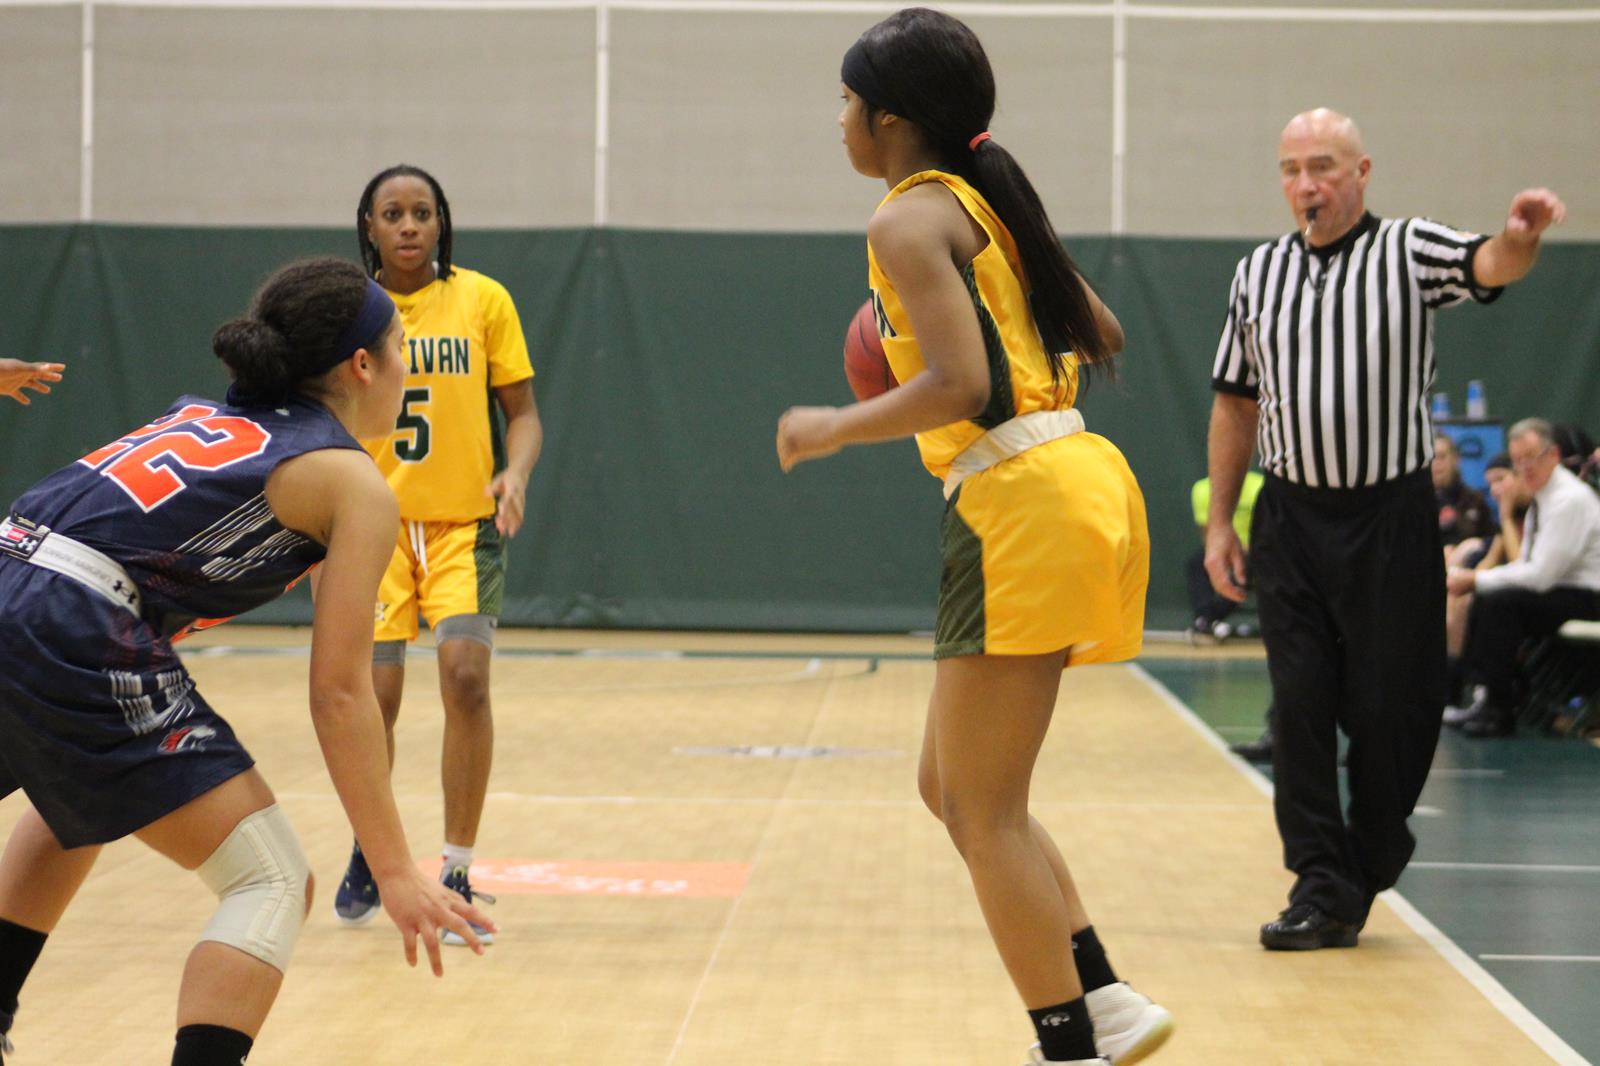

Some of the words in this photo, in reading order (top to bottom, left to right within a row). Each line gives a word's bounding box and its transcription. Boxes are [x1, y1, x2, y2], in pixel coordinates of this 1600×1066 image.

[407, 336, 470, 375] IVAN
[76, 404, 272, 514] 22
[394, 386, 432, 464] 5
